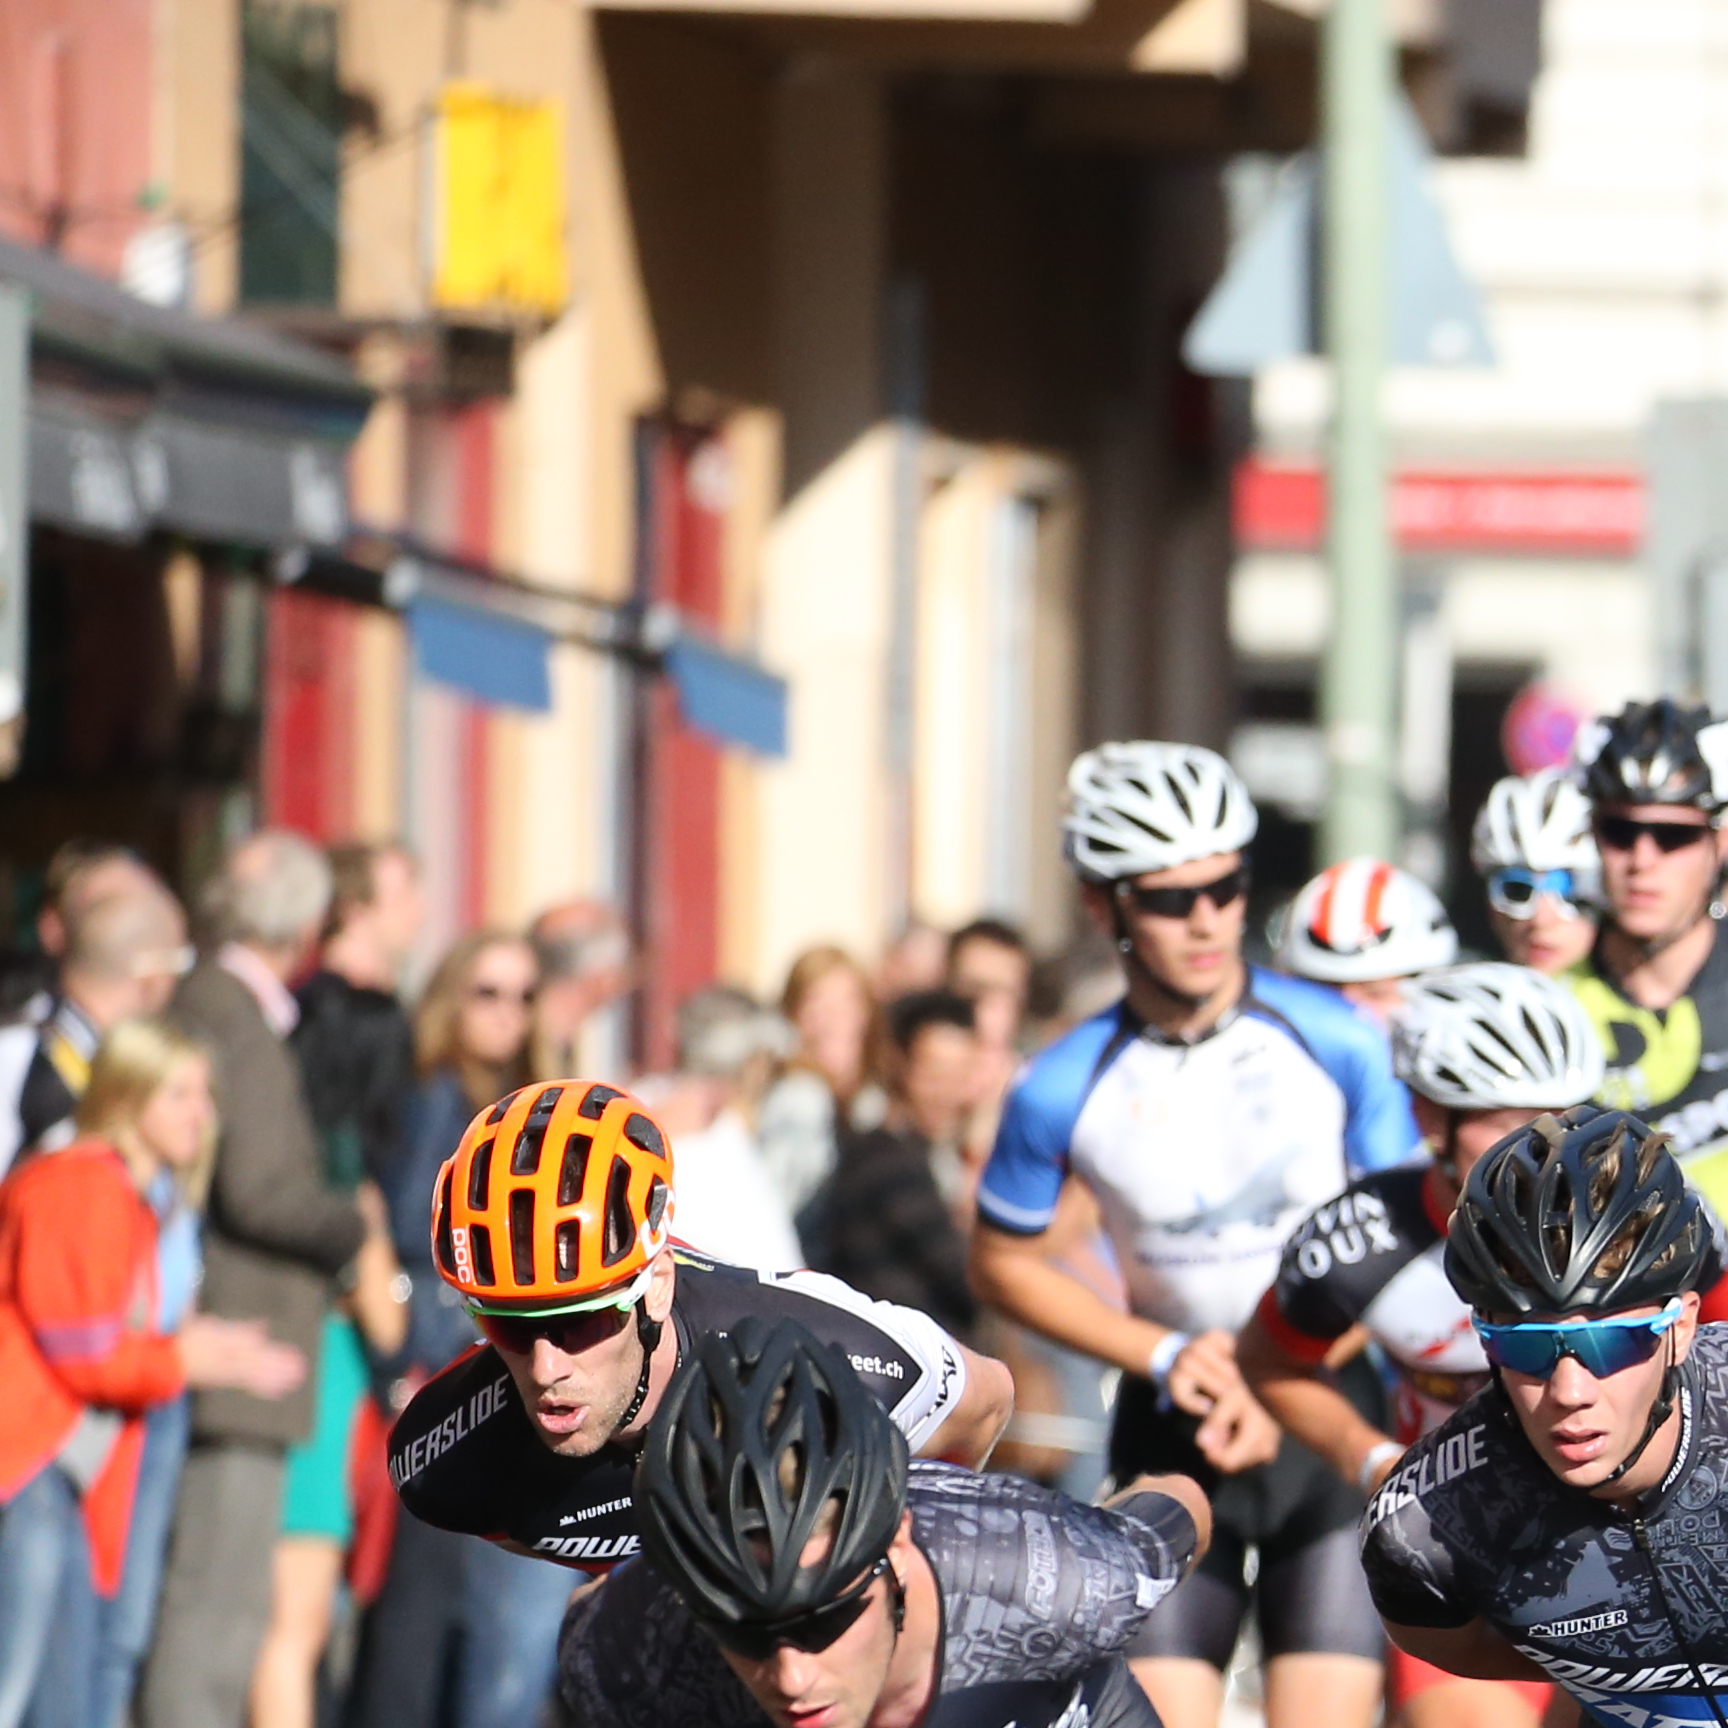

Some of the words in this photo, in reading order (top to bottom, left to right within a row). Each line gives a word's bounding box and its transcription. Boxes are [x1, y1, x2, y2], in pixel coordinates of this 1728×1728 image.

[848, 1354, 904, 1380] eet.ch
[576, 1496, 632, 1521] HUNTER
[1551, 1610, 1628, 1637] HUNTER
